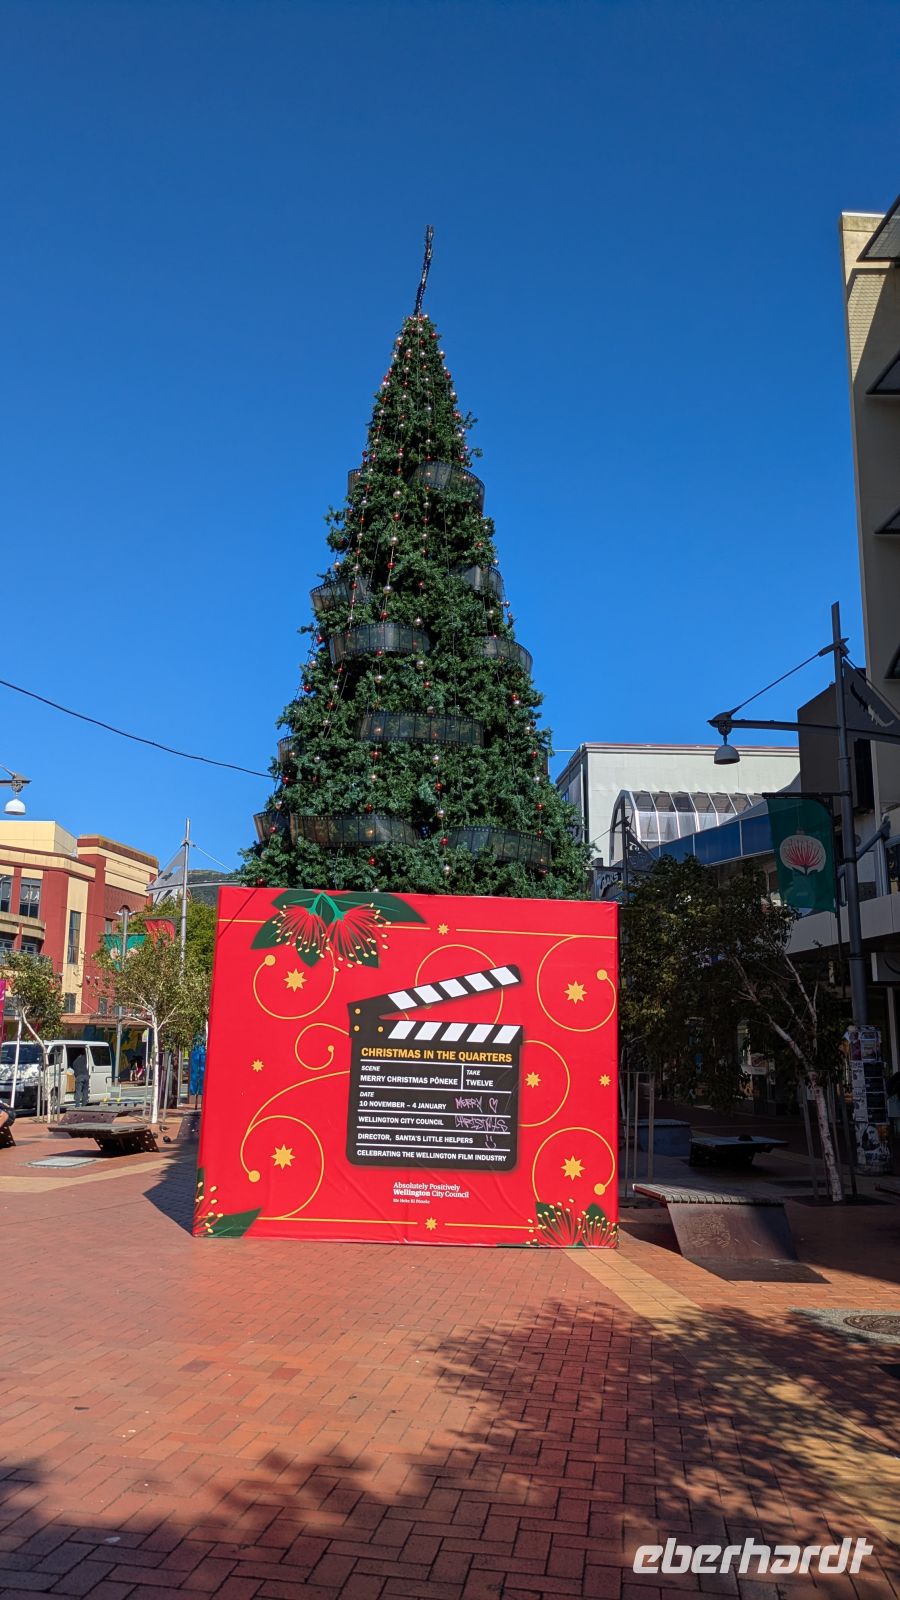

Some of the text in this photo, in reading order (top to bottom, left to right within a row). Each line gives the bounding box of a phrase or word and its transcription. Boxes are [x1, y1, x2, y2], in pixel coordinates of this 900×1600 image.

[361, 1047, 512, 1062] CHRISTMAS IN THE QUARTERS
[386, 1076, 428, 1084] CHRISTMAS
[358, 1133, 392, 1141] DIRECTOR,
[393, 1182, 461, 1192] Absolutely Positively
[393, 1189, 430, 1197] Wellington
